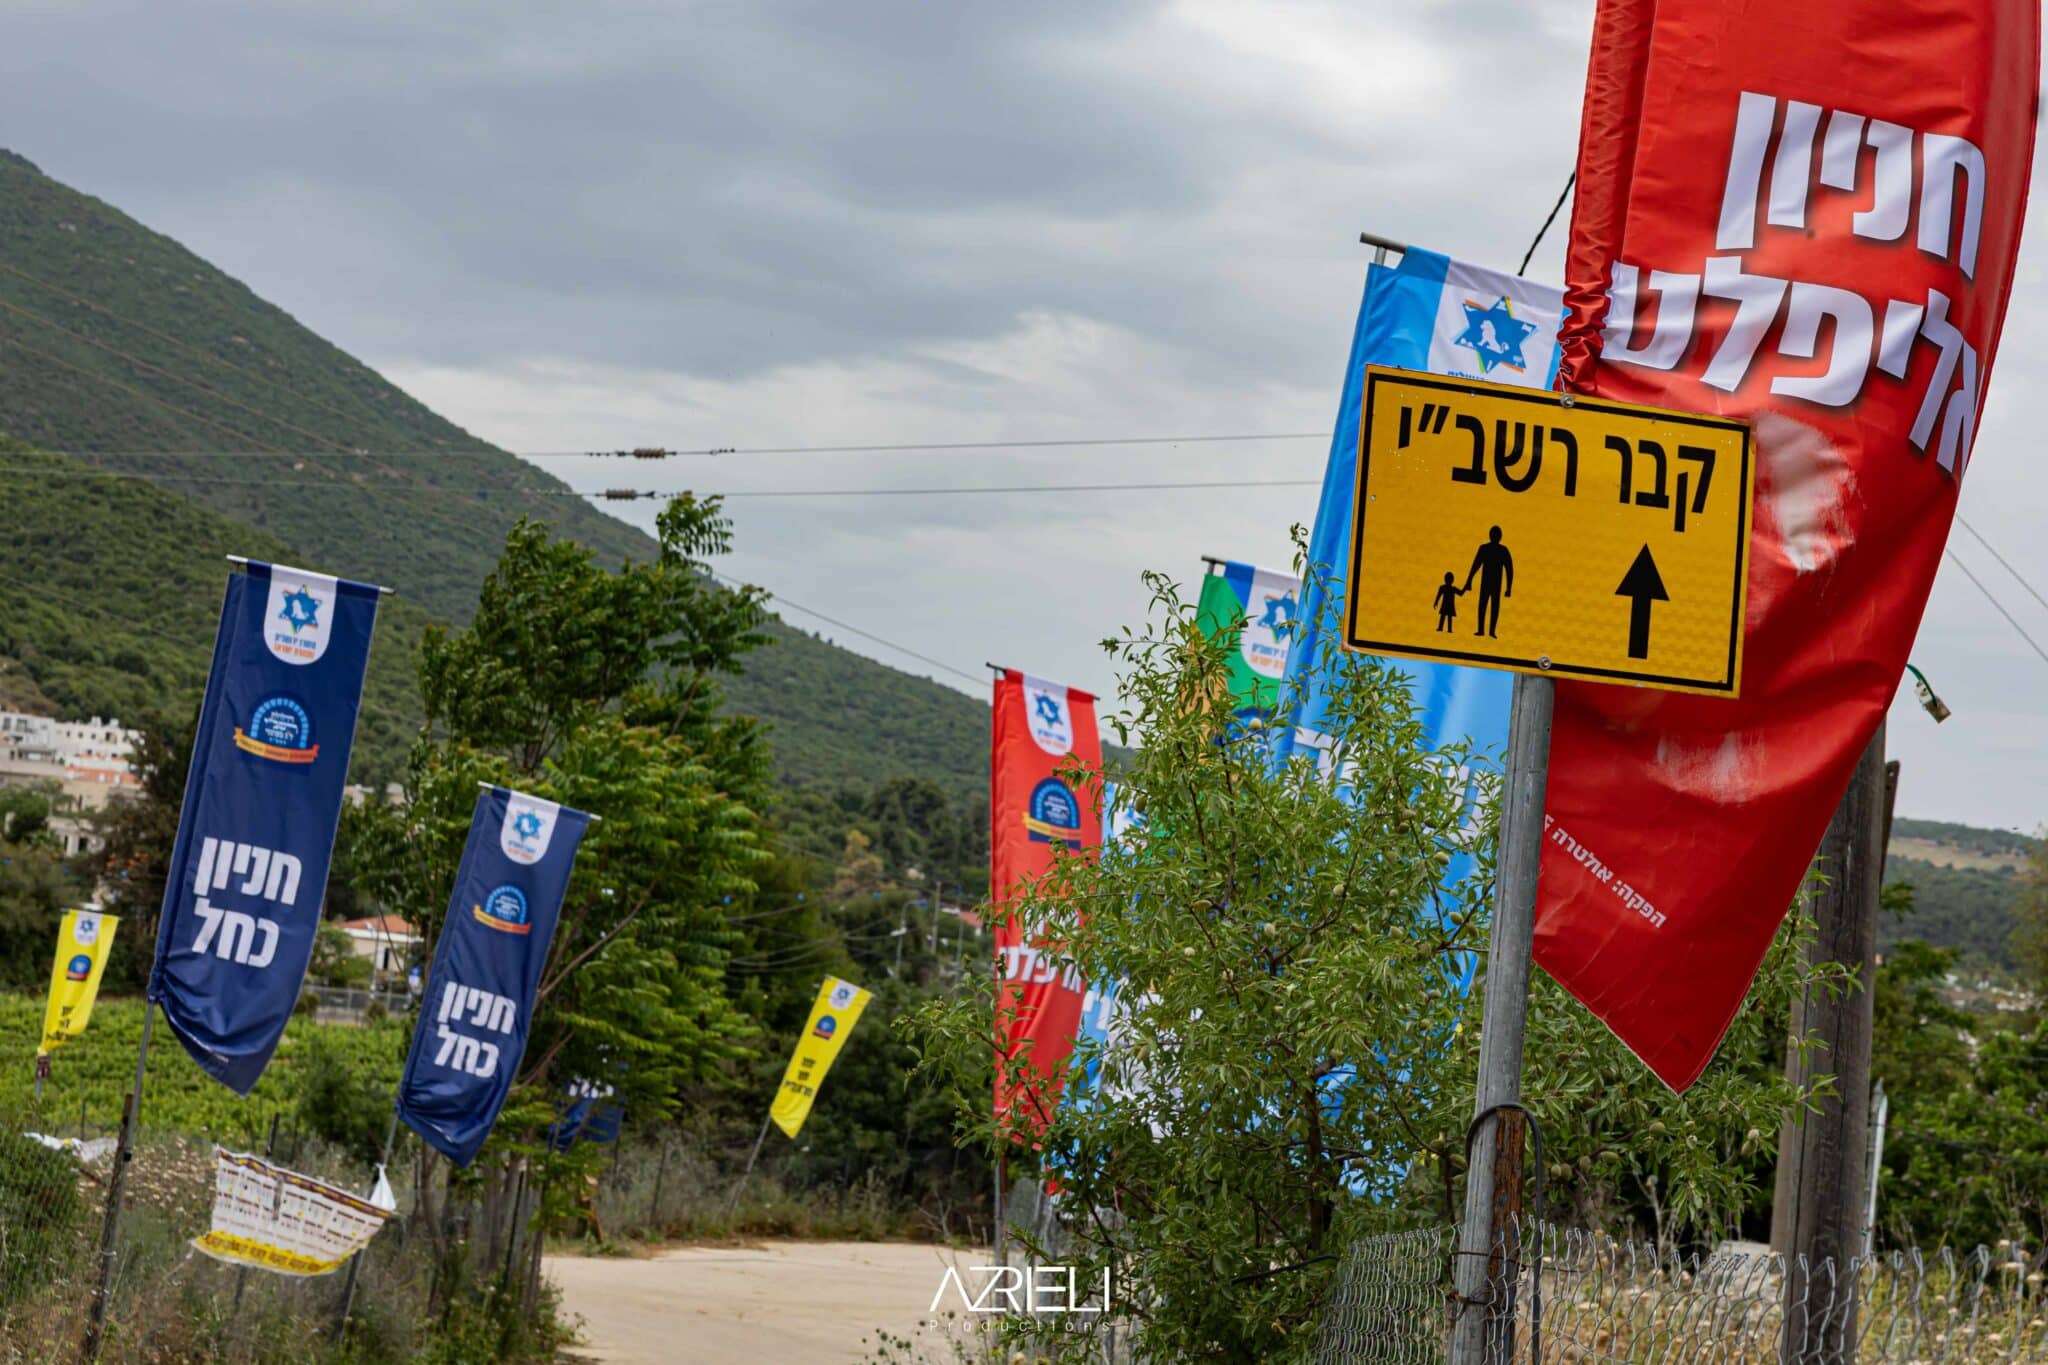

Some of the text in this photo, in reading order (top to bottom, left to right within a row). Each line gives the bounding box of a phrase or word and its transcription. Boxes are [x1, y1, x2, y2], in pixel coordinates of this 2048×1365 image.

[1715, 91, 1987, 281] חניון
[1599, 256, 1984, 480] אליפלט
[1605, 435, 1716, 533] קבר
[194, 838, 303, 906] חניון
[1551, 827, 1667, 928] הפקה: אולטרה
[192, 899, 281, 968] כחל
[438, 982, 517, 1034] חניון
[435, 1026, 500, 1077] כחל
